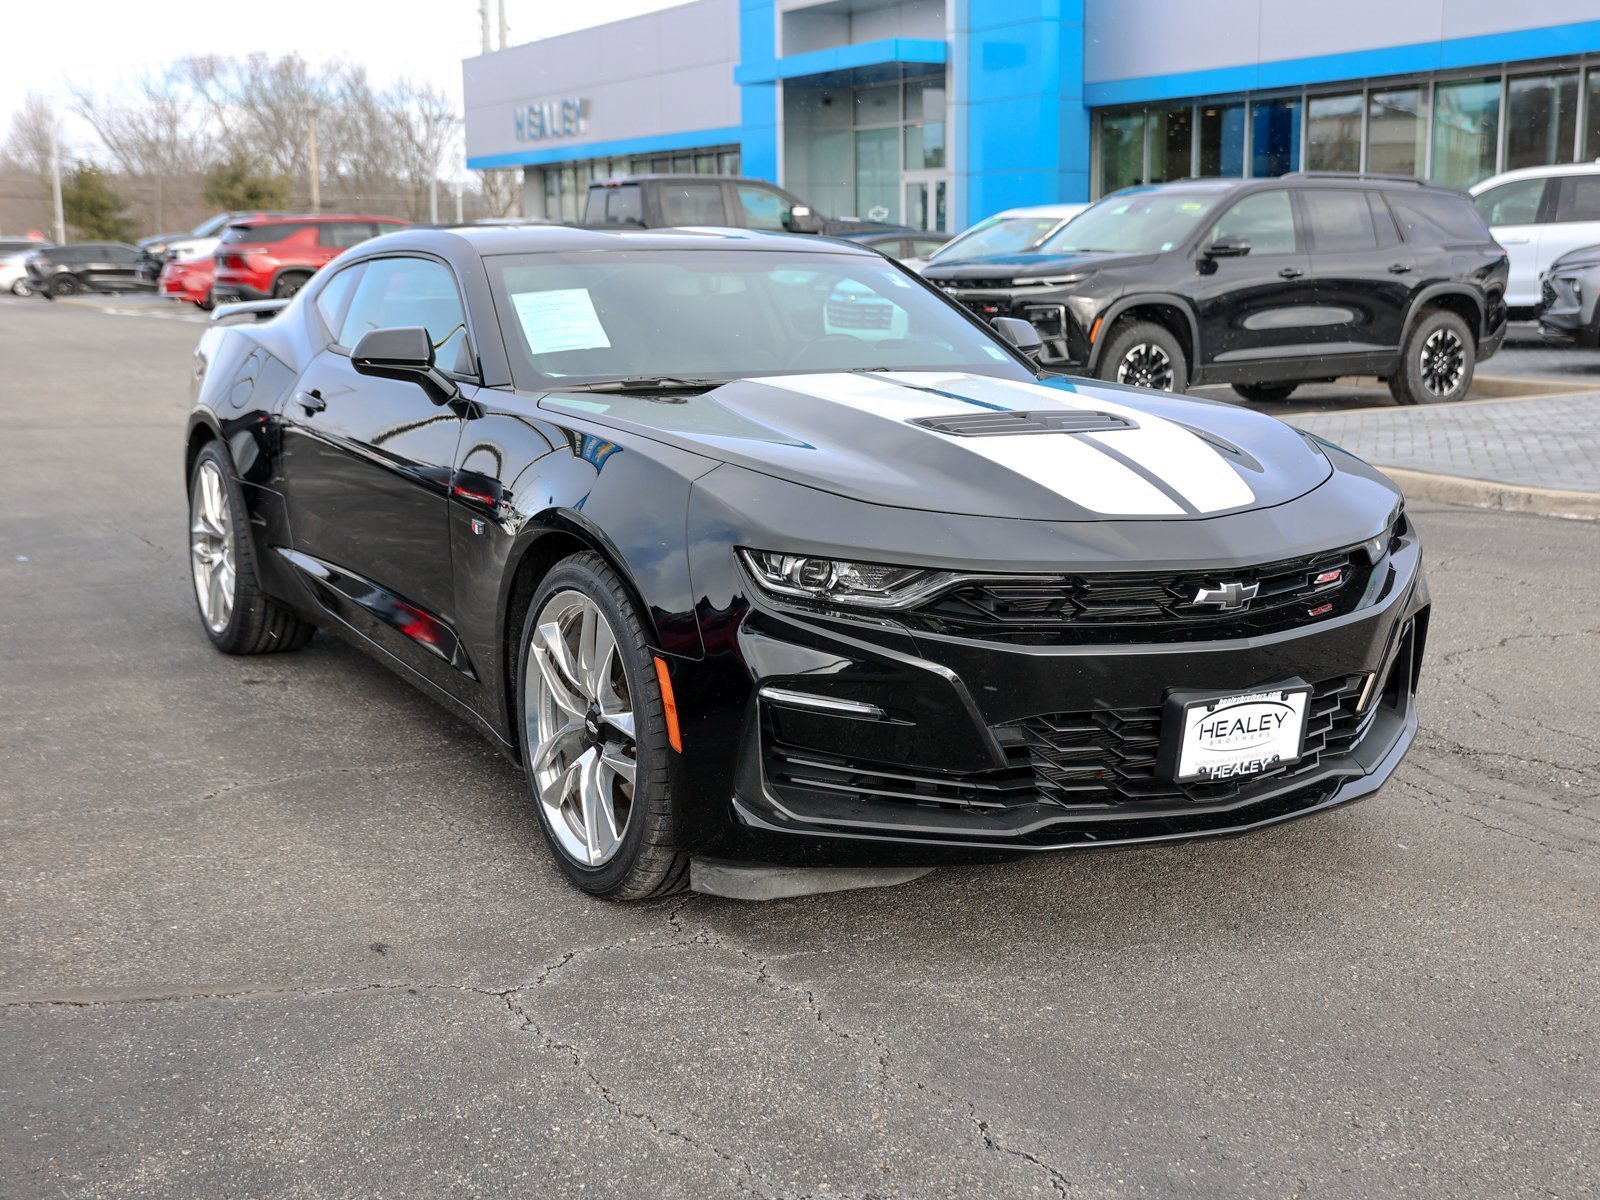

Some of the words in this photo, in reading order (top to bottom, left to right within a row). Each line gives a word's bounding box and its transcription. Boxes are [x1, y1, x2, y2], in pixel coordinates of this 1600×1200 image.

[1199, 711, 1288, 740] HEALEY
[1209, 732, 1270, 746] BROTHERS
[1210, 758, 1269, 780] HEALEY
